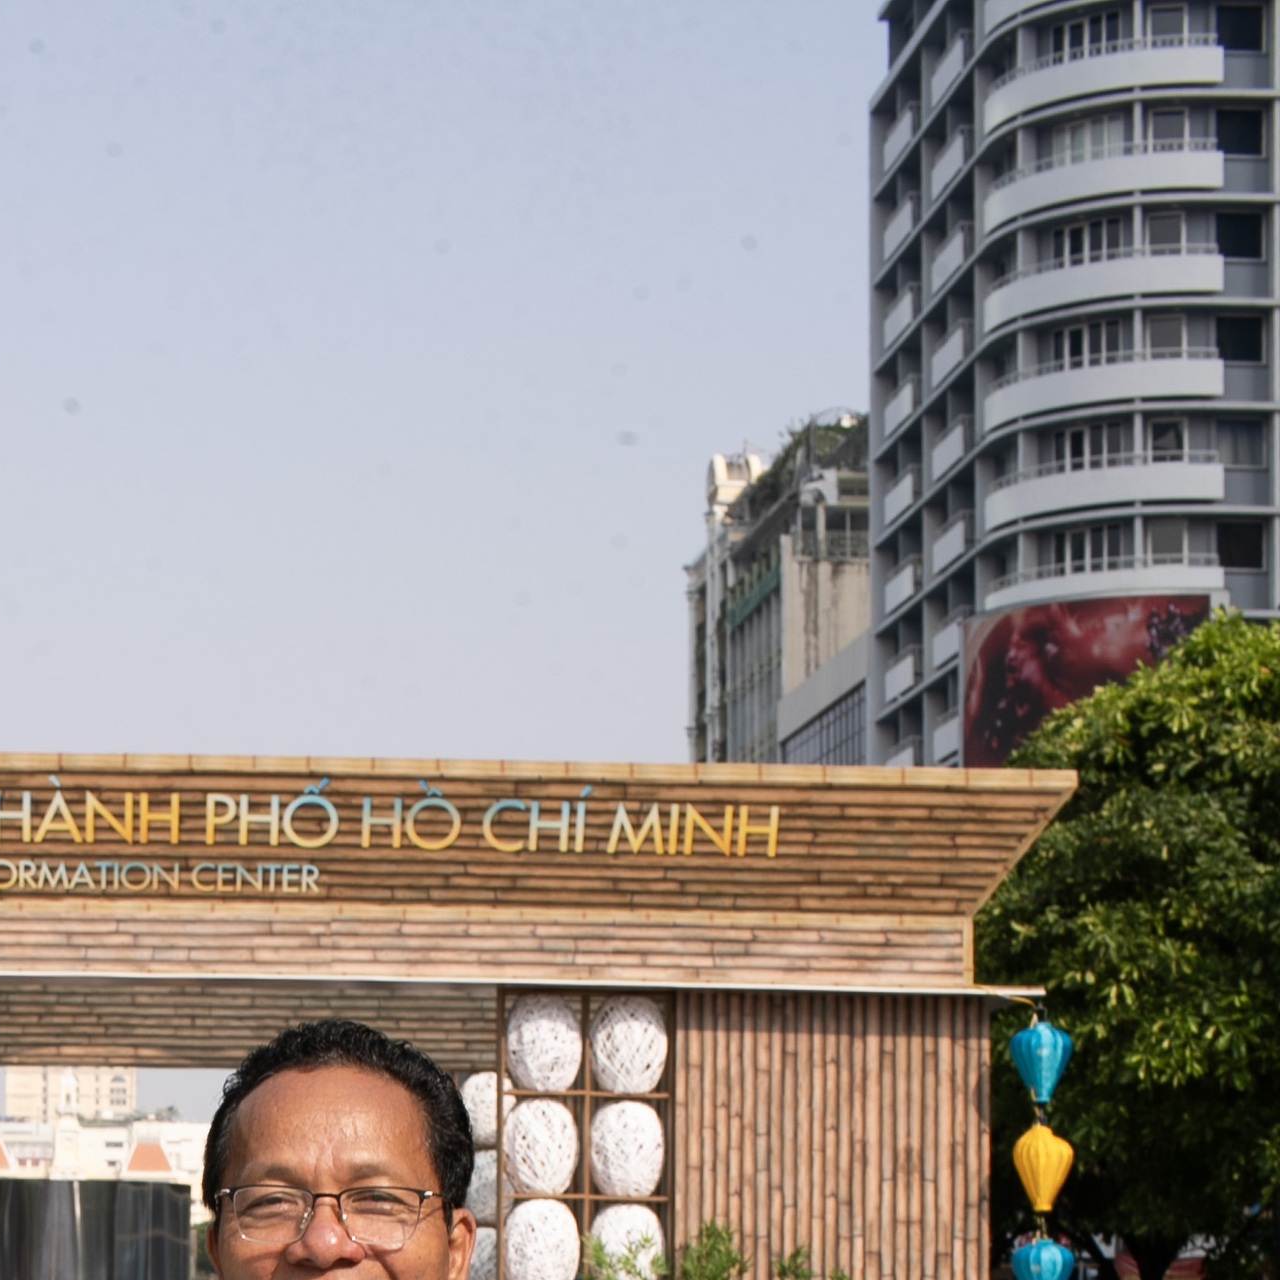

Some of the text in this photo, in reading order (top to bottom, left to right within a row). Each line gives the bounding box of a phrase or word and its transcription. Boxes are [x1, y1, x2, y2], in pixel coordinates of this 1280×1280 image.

[206, 778, 340, 848] PHỐ
[362, 781, 462, 850] HỒ
[483, 786, 593, 852] CHÍ
[607, 803, 780, 857] MINH
[192, 863, 320, 893] CENTER
